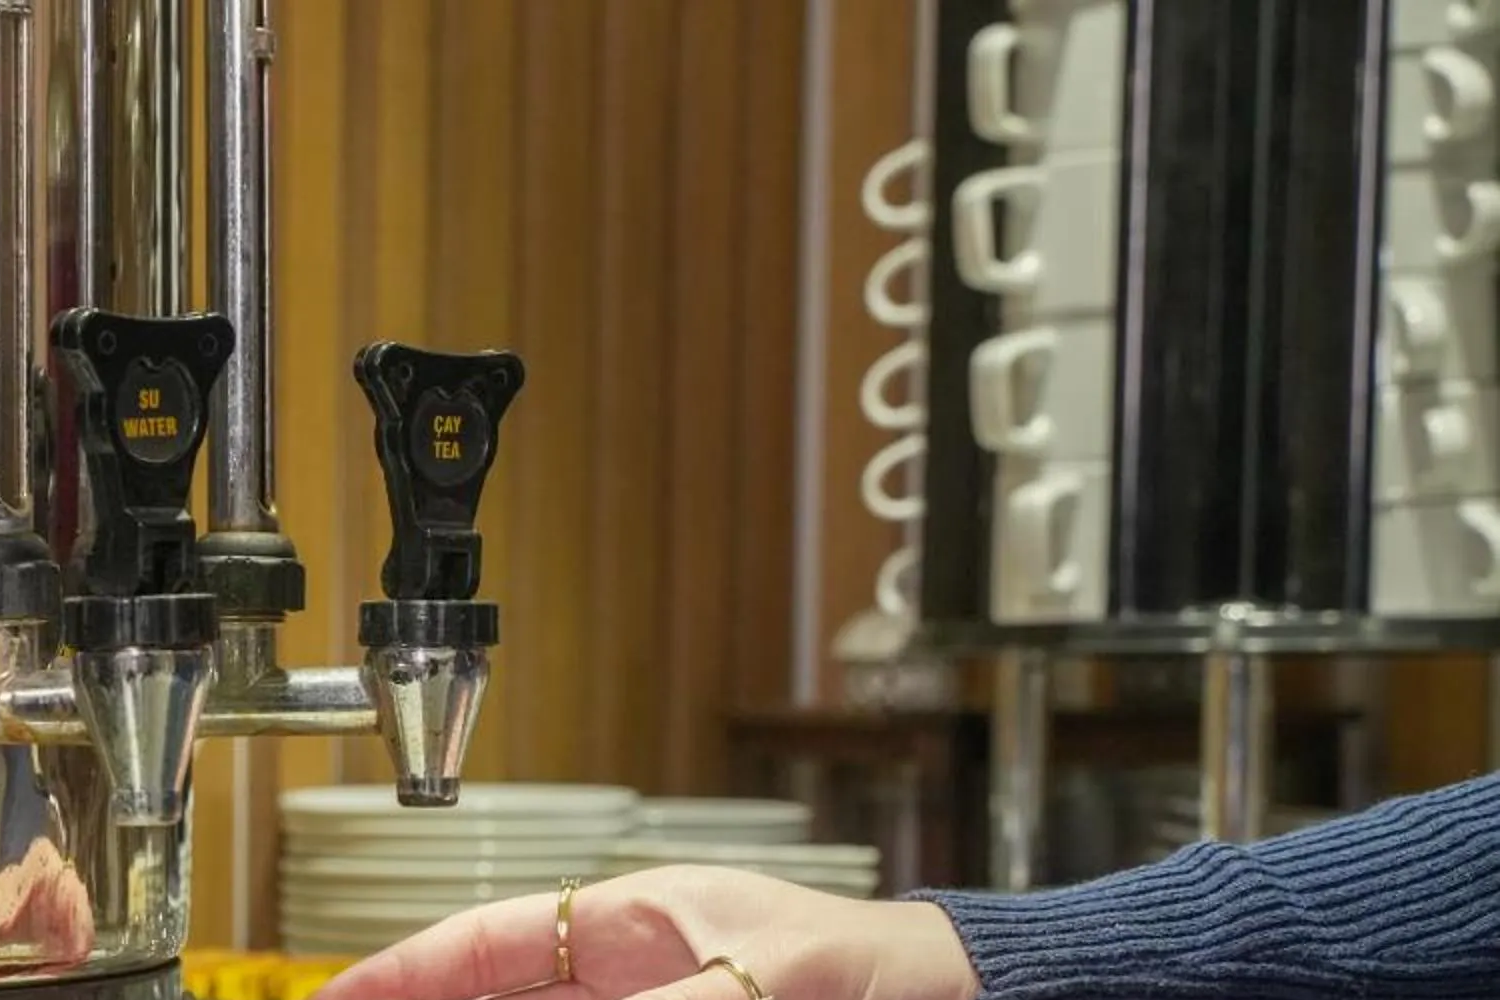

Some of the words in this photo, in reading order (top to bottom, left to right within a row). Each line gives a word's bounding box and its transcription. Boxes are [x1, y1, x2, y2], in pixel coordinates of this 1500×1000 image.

[138, 389, 160, 410] SU
[123, 416, 178, 438] WATER
[433, 415, 462, 438] ÇAY
[433, 441, 461, 460] TEA
